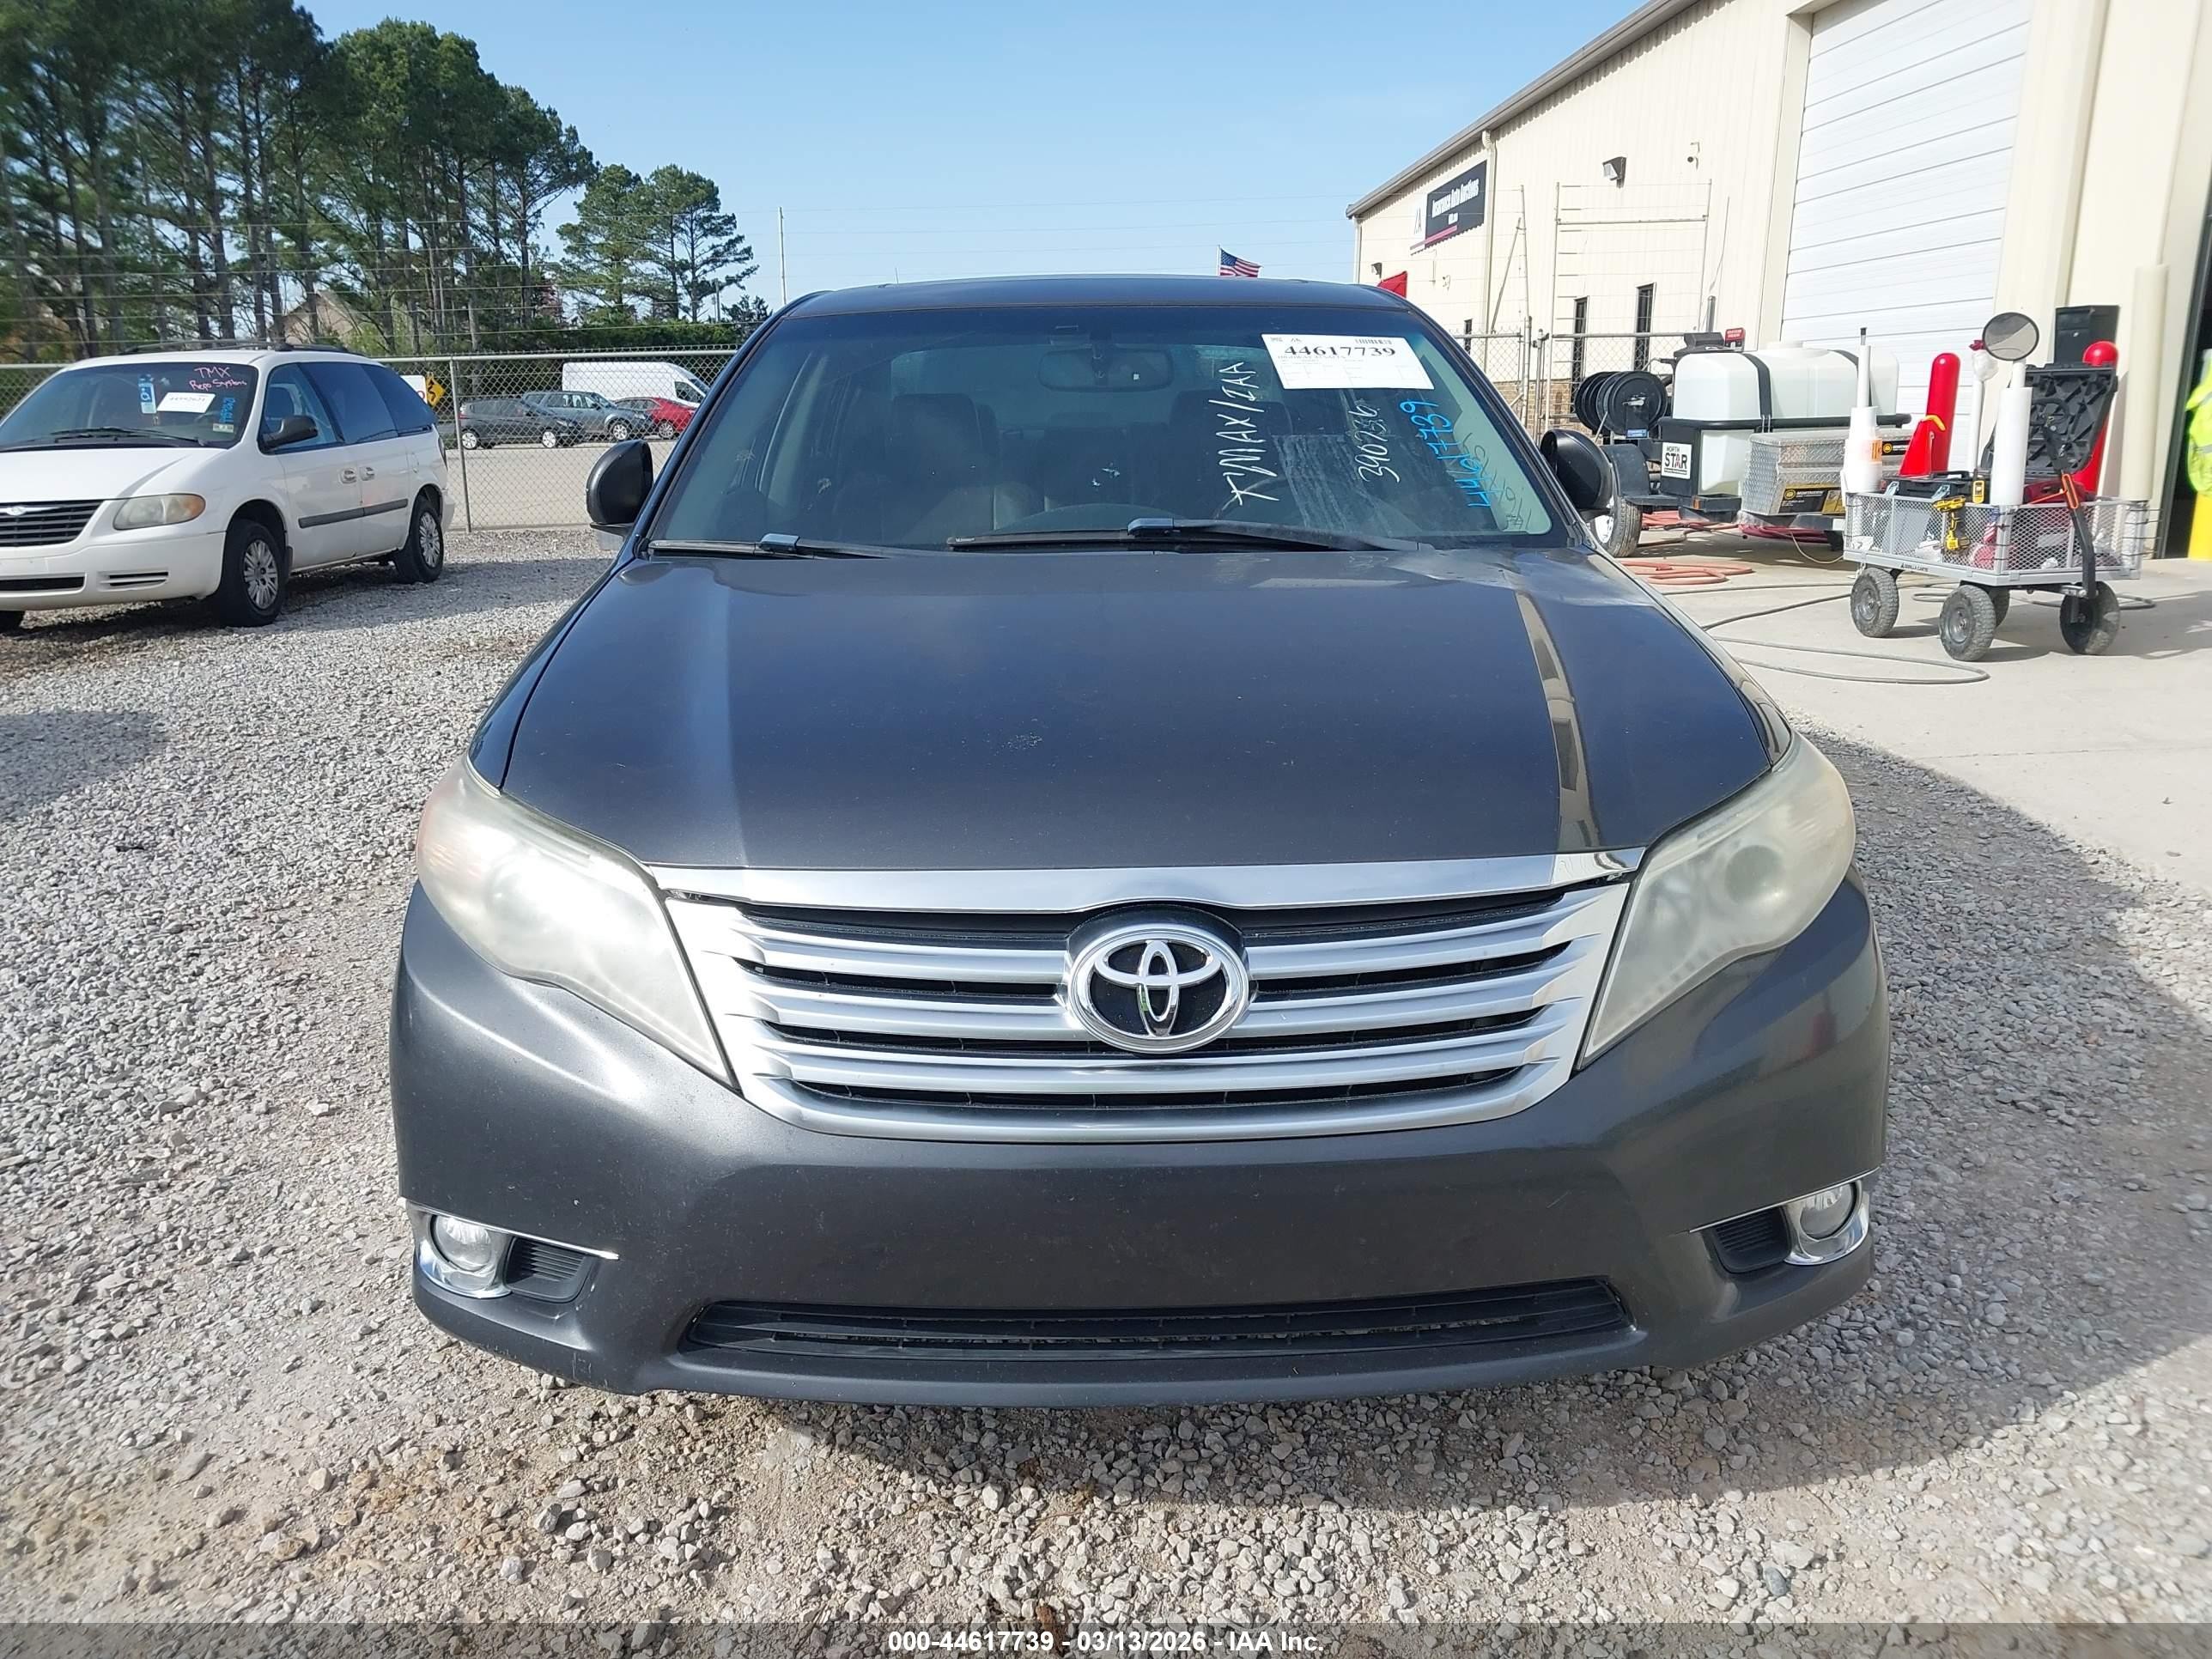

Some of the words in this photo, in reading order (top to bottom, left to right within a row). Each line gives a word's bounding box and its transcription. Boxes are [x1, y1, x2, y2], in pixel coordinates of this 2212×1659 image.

[1284, 346, 1396, 356] 44617739
[194, 367, 231, 378] TMX
[189, 380, 212, 392] Repo
[1400, 398, 1491, 507] 44617739
[1665, 453, 1688, 469] STAR
